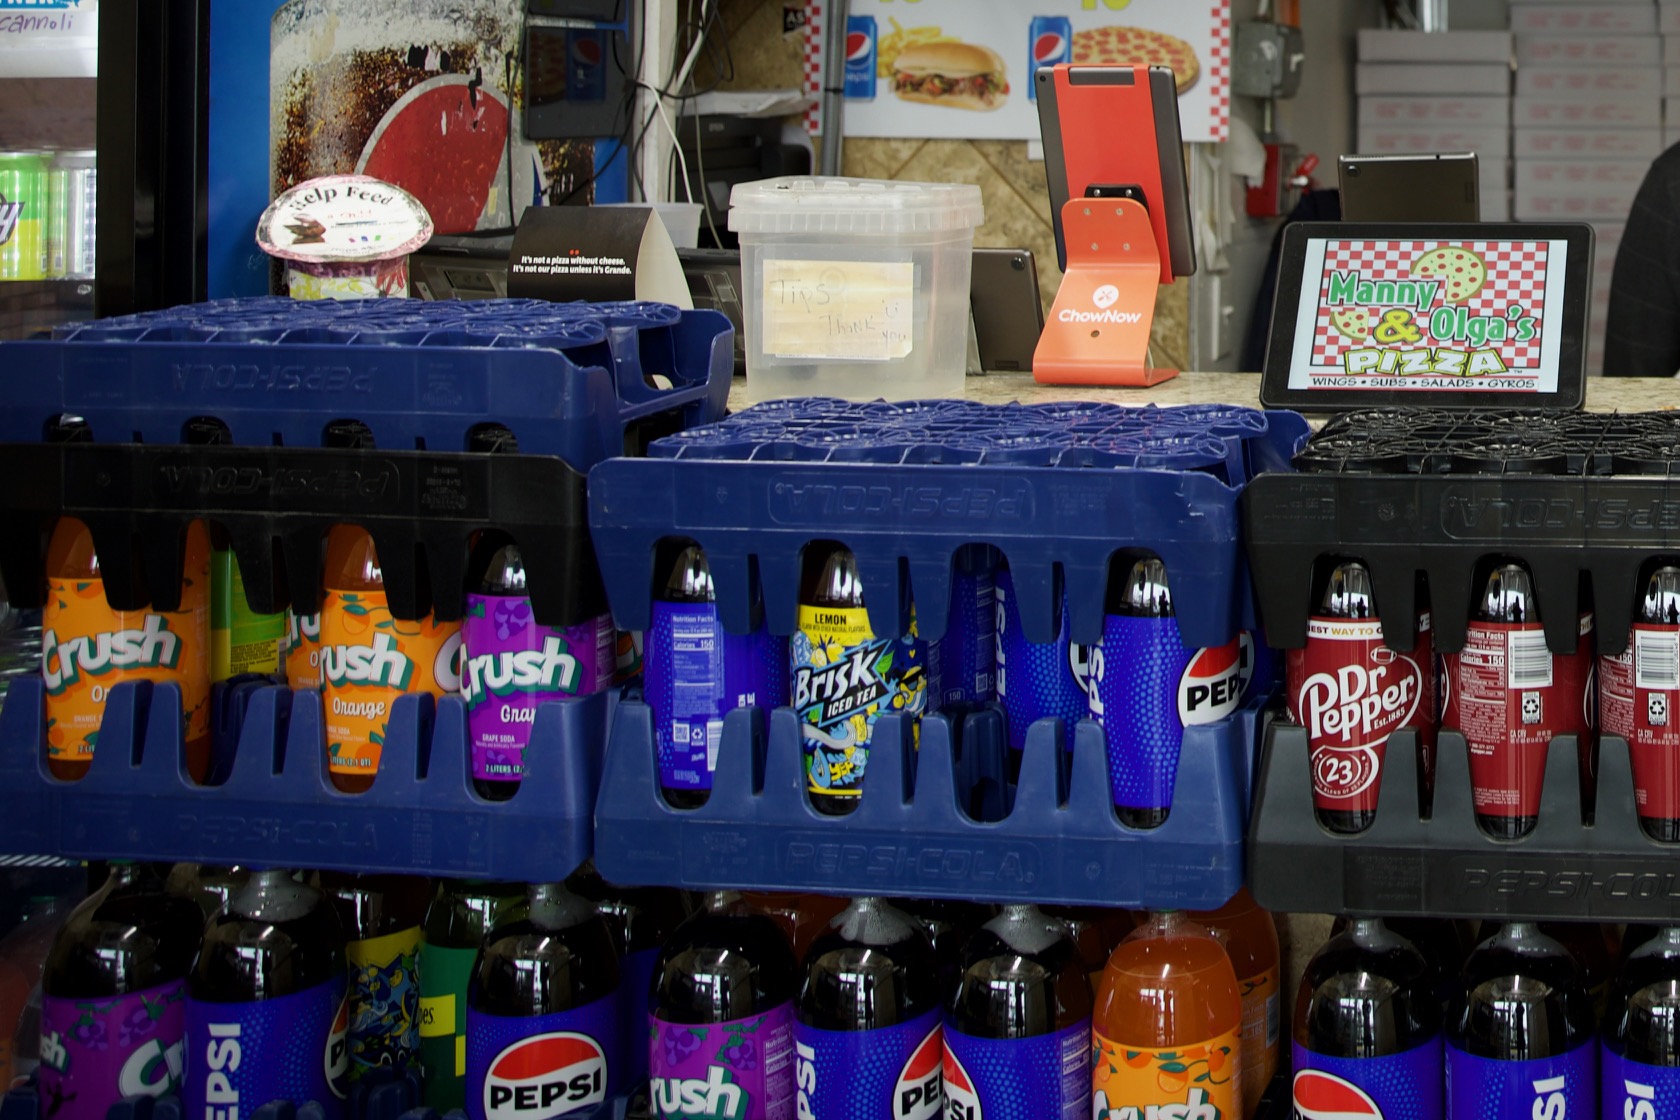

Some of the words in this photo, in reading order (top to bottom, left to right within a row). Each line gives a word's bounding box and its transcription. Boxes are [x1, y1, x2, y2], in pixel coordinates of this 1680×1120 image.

[0, 12, 73, 35] cannoli
[290, 187, 338, 211] Help
[346, 186, 393, 205] Feed
[513, 264, 524, 272] It's
[525, 265, 537, 273] not
[538, 265, 551, 273] our
[550, 265, 569, 275] pizza
[570, 265, 592, 274] unless
[592, 265, 604, 274] it's
[604, 265, 632, 274] Grande.
[521, 256, 532, 264] It's
[533, 256, 546, 264] not
[551, 256, 570, 266] pizza
[570, 256, 598, 265] without
[599, 256, 626, 266] cheese.
[770, 279, 831, 314] Tips
[1326, 269, 1439, 312] Manny
[1058, 308, 1142, 324] ChowNow
[1373, 307, 1424, 344] &
[1429, 303, 1538, 348] Olga's
[1344, 347, 1510, 377] PIZZA
[1312, 376, 1357, 387] WINGS
[1370, 377, 1407, 387] SUBS
[1421, 378, 1475, 388] SALADS
[1488, 379, 1535, 388] GYROS
[814, 613, 848, 625] LEMON
[1331, 627, 1355, 636] WAY
[1359, 627, 1374, 636] TO
[43, 615, 180, 691] Crush
[459, 636, 577, 703] Crush
[1337, 664, 1387, 705] Dr
[333, 696, 386, 719] Orange
[827, 694, 854, 719] ICED
[856, 684, 877, 706] TEA
[1299, 672, 1415, 742] Pepper
[499, 734, 516, 742] SODA
[1325, 758, 1353, 784] 23
[490, 1070, 602, 1111] PEPSI
